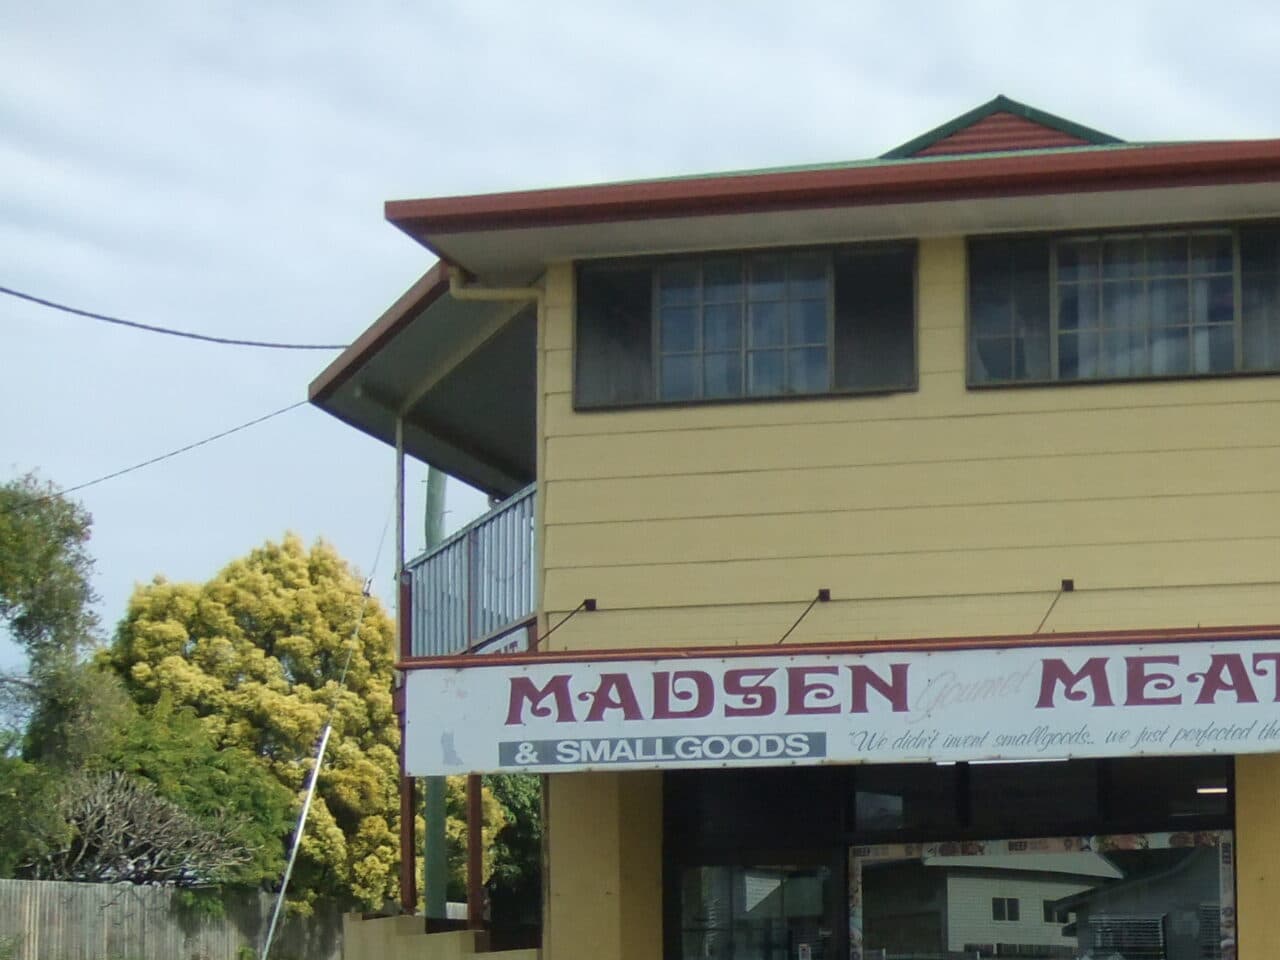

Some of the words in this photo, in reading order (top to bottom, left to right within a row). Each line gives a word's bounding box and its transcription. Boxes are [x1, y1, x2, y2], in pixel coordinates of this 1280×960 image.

[505, 664, 911, 725] MADSEN
[515, 743, 539, 764] &
[556, 733, 810, 763] SMALLGOODS
[892, 729, 939, 750] didn't
[942, 729, 989, 749] invent
[1105, 728, 1130, 744] we
[1130, 725, 1170, 750] just
[1169, 720, 1258, 747] perfected
